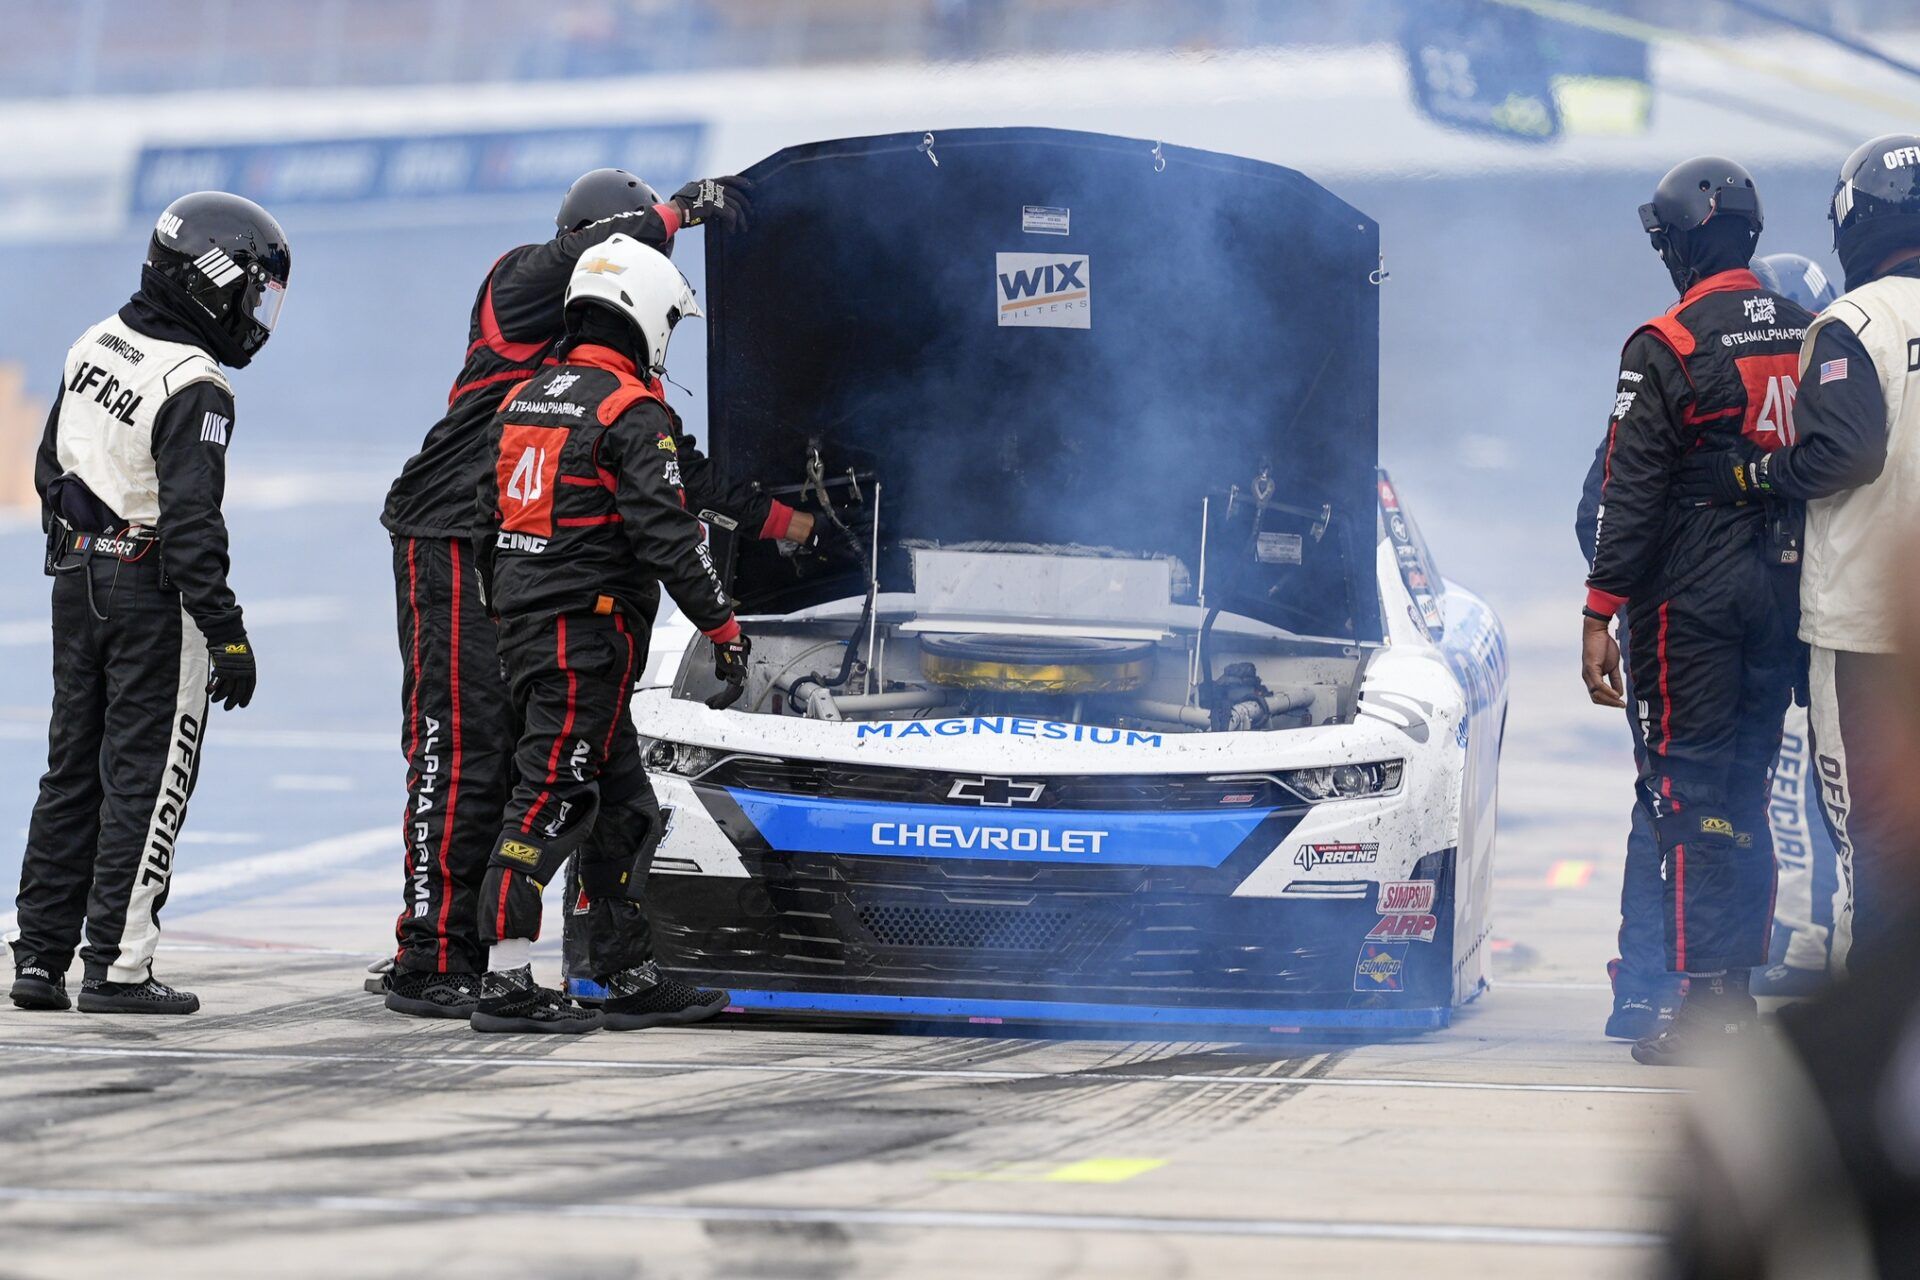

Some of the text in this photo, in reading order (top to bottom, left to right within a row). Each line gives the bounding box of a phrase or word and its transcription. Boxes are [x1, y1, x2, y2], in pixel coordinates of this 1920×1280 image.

[998, 261, 1086, 300] WIX
[1001, 299, 1087, 321] FILTERS
[94, 537, 136, 556] ASCAR
[856, 717, 1162, 748] MAGNESIUM
[141, 713, 198, 888] OFFICIAL
[413, 715, 440, 919] ALPHA PRIME
[871, 822, 1109, 854] CHEVROLET
[1321, 850, 1377, 863] RACING
[1383, 885, 1431, 909] SIMPSON
[1367, 914, 1437, 936] ARP
[1360, 960, 1401, 973] SUNOCO
